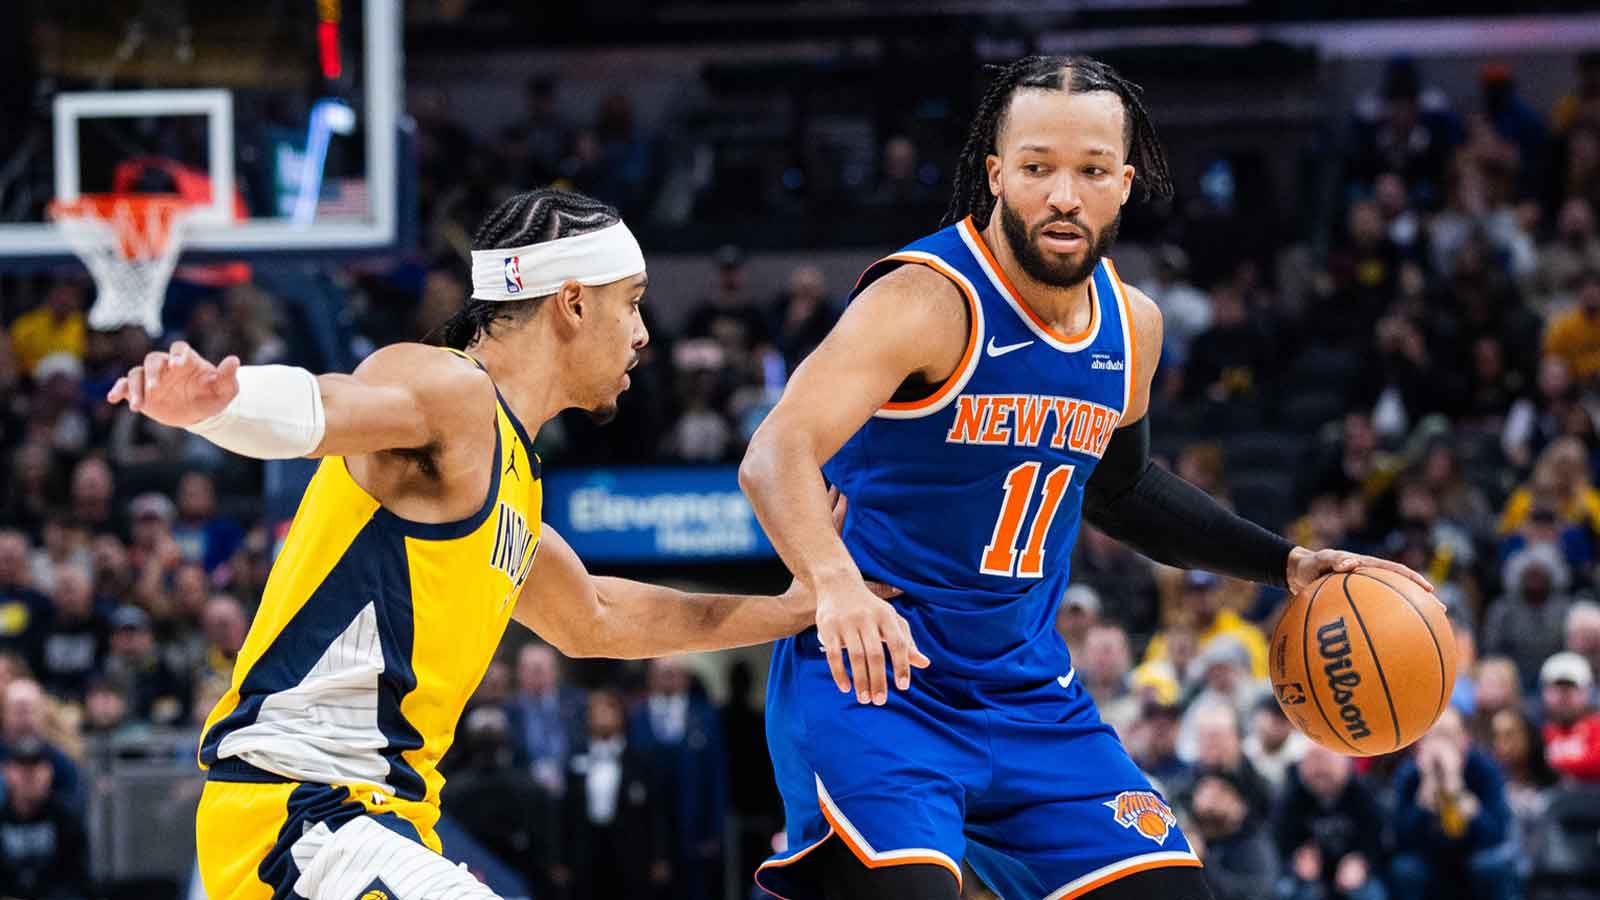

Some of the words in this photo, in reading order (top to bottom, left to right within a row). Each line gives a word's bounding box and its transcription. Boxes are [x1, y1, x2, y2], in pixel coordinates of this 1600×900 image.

[946, 394, 1052, 446] NEW
[980, 461, 1075, 578] 11
[1317, 616, 1371, 740] Wilson
